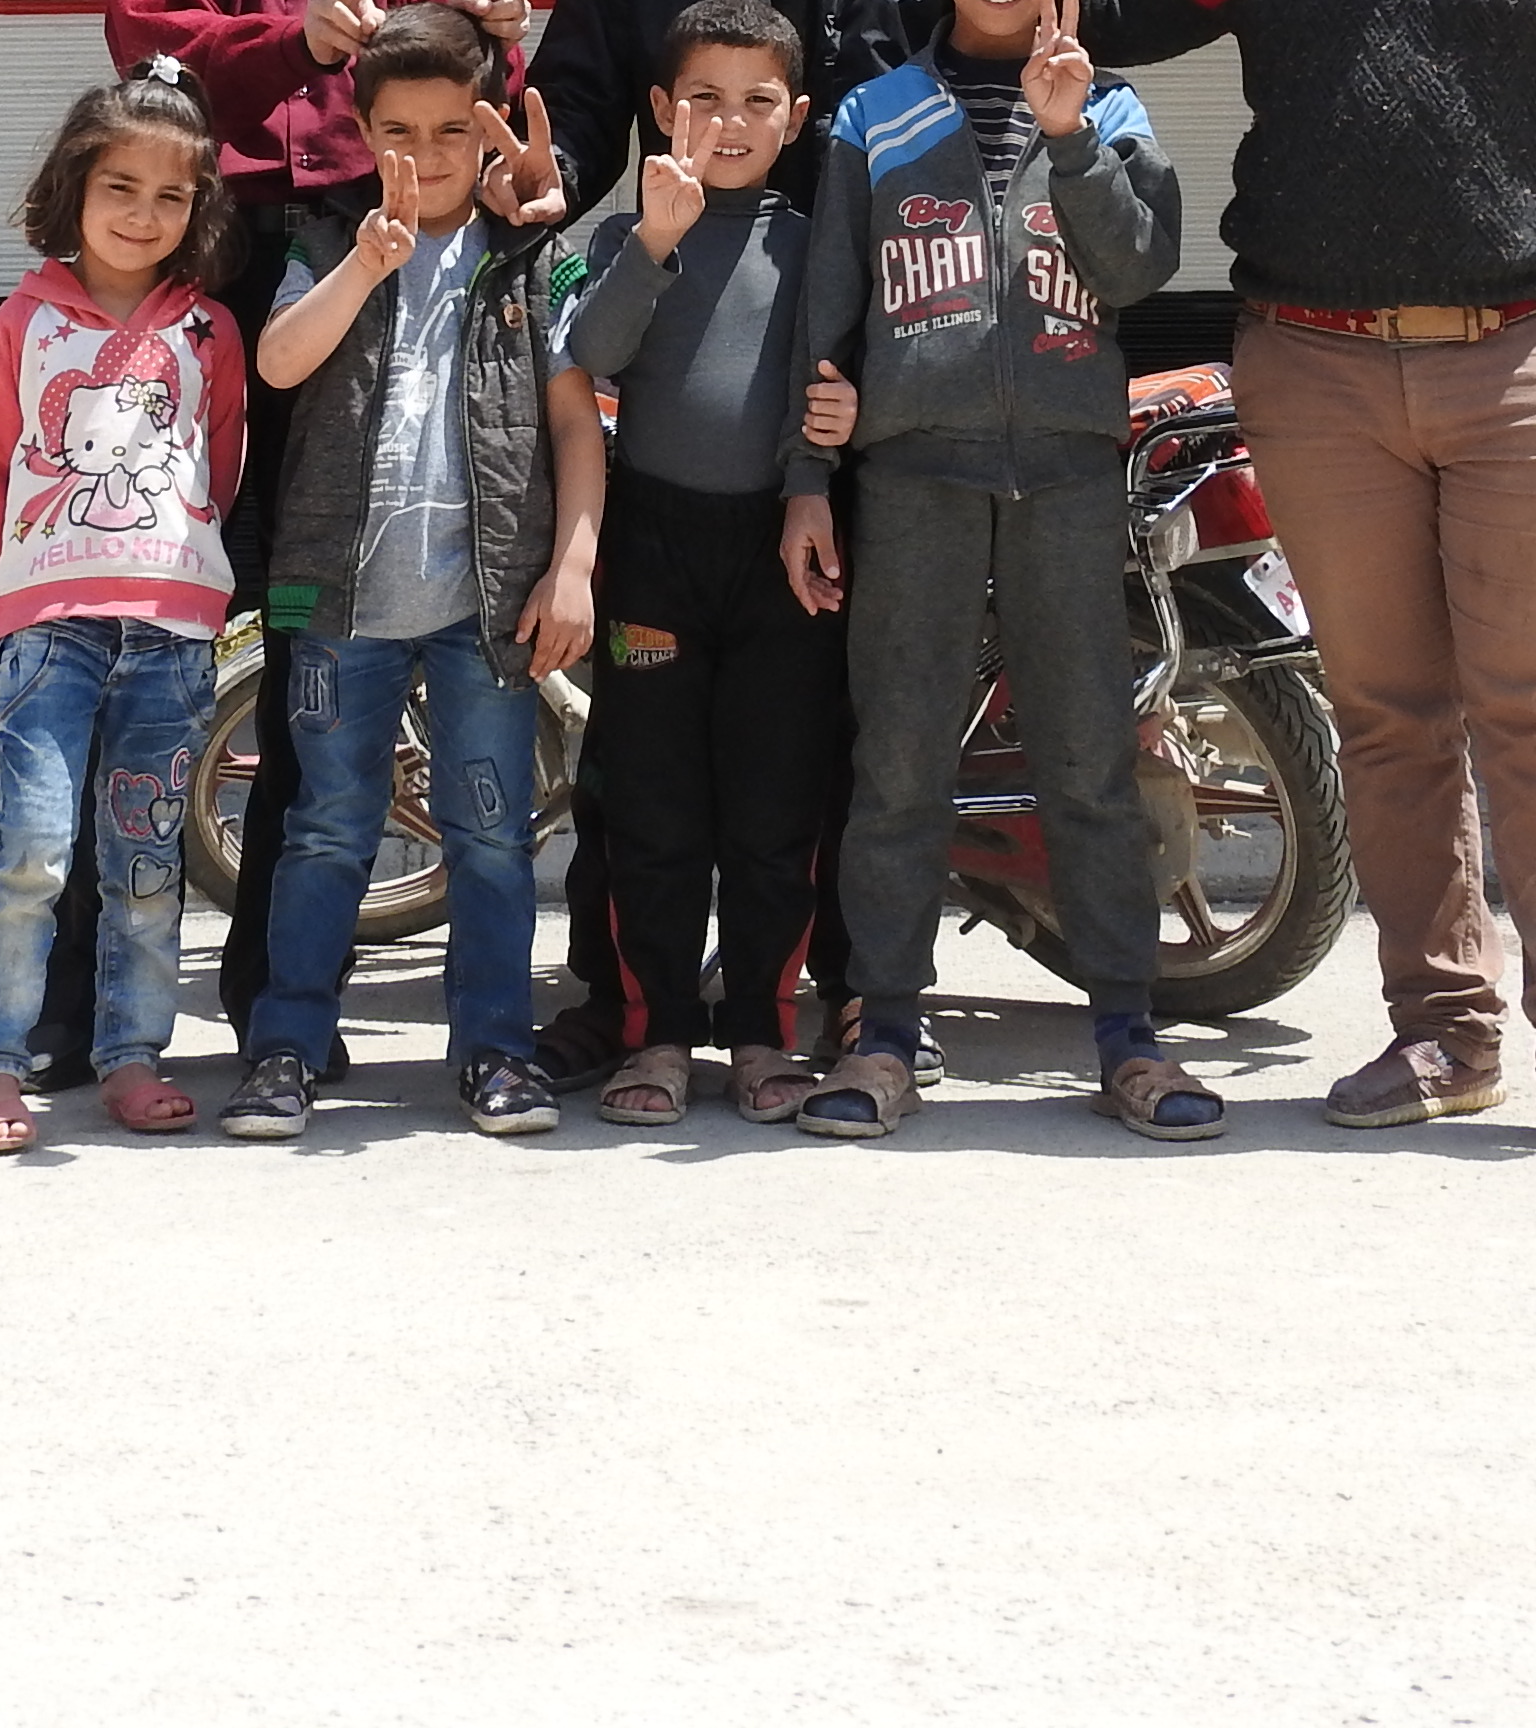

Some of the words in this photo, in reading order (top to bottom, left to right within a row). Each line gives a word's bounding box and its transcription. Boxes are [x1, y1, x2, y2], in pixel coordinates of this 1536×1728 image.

[894, 320, 928, 339] BLADE
[932, 310, 982, 330] ILLINOIS
[29, 536, 125, 576] HELLO
[132, 536, 205, 574] KITTY
